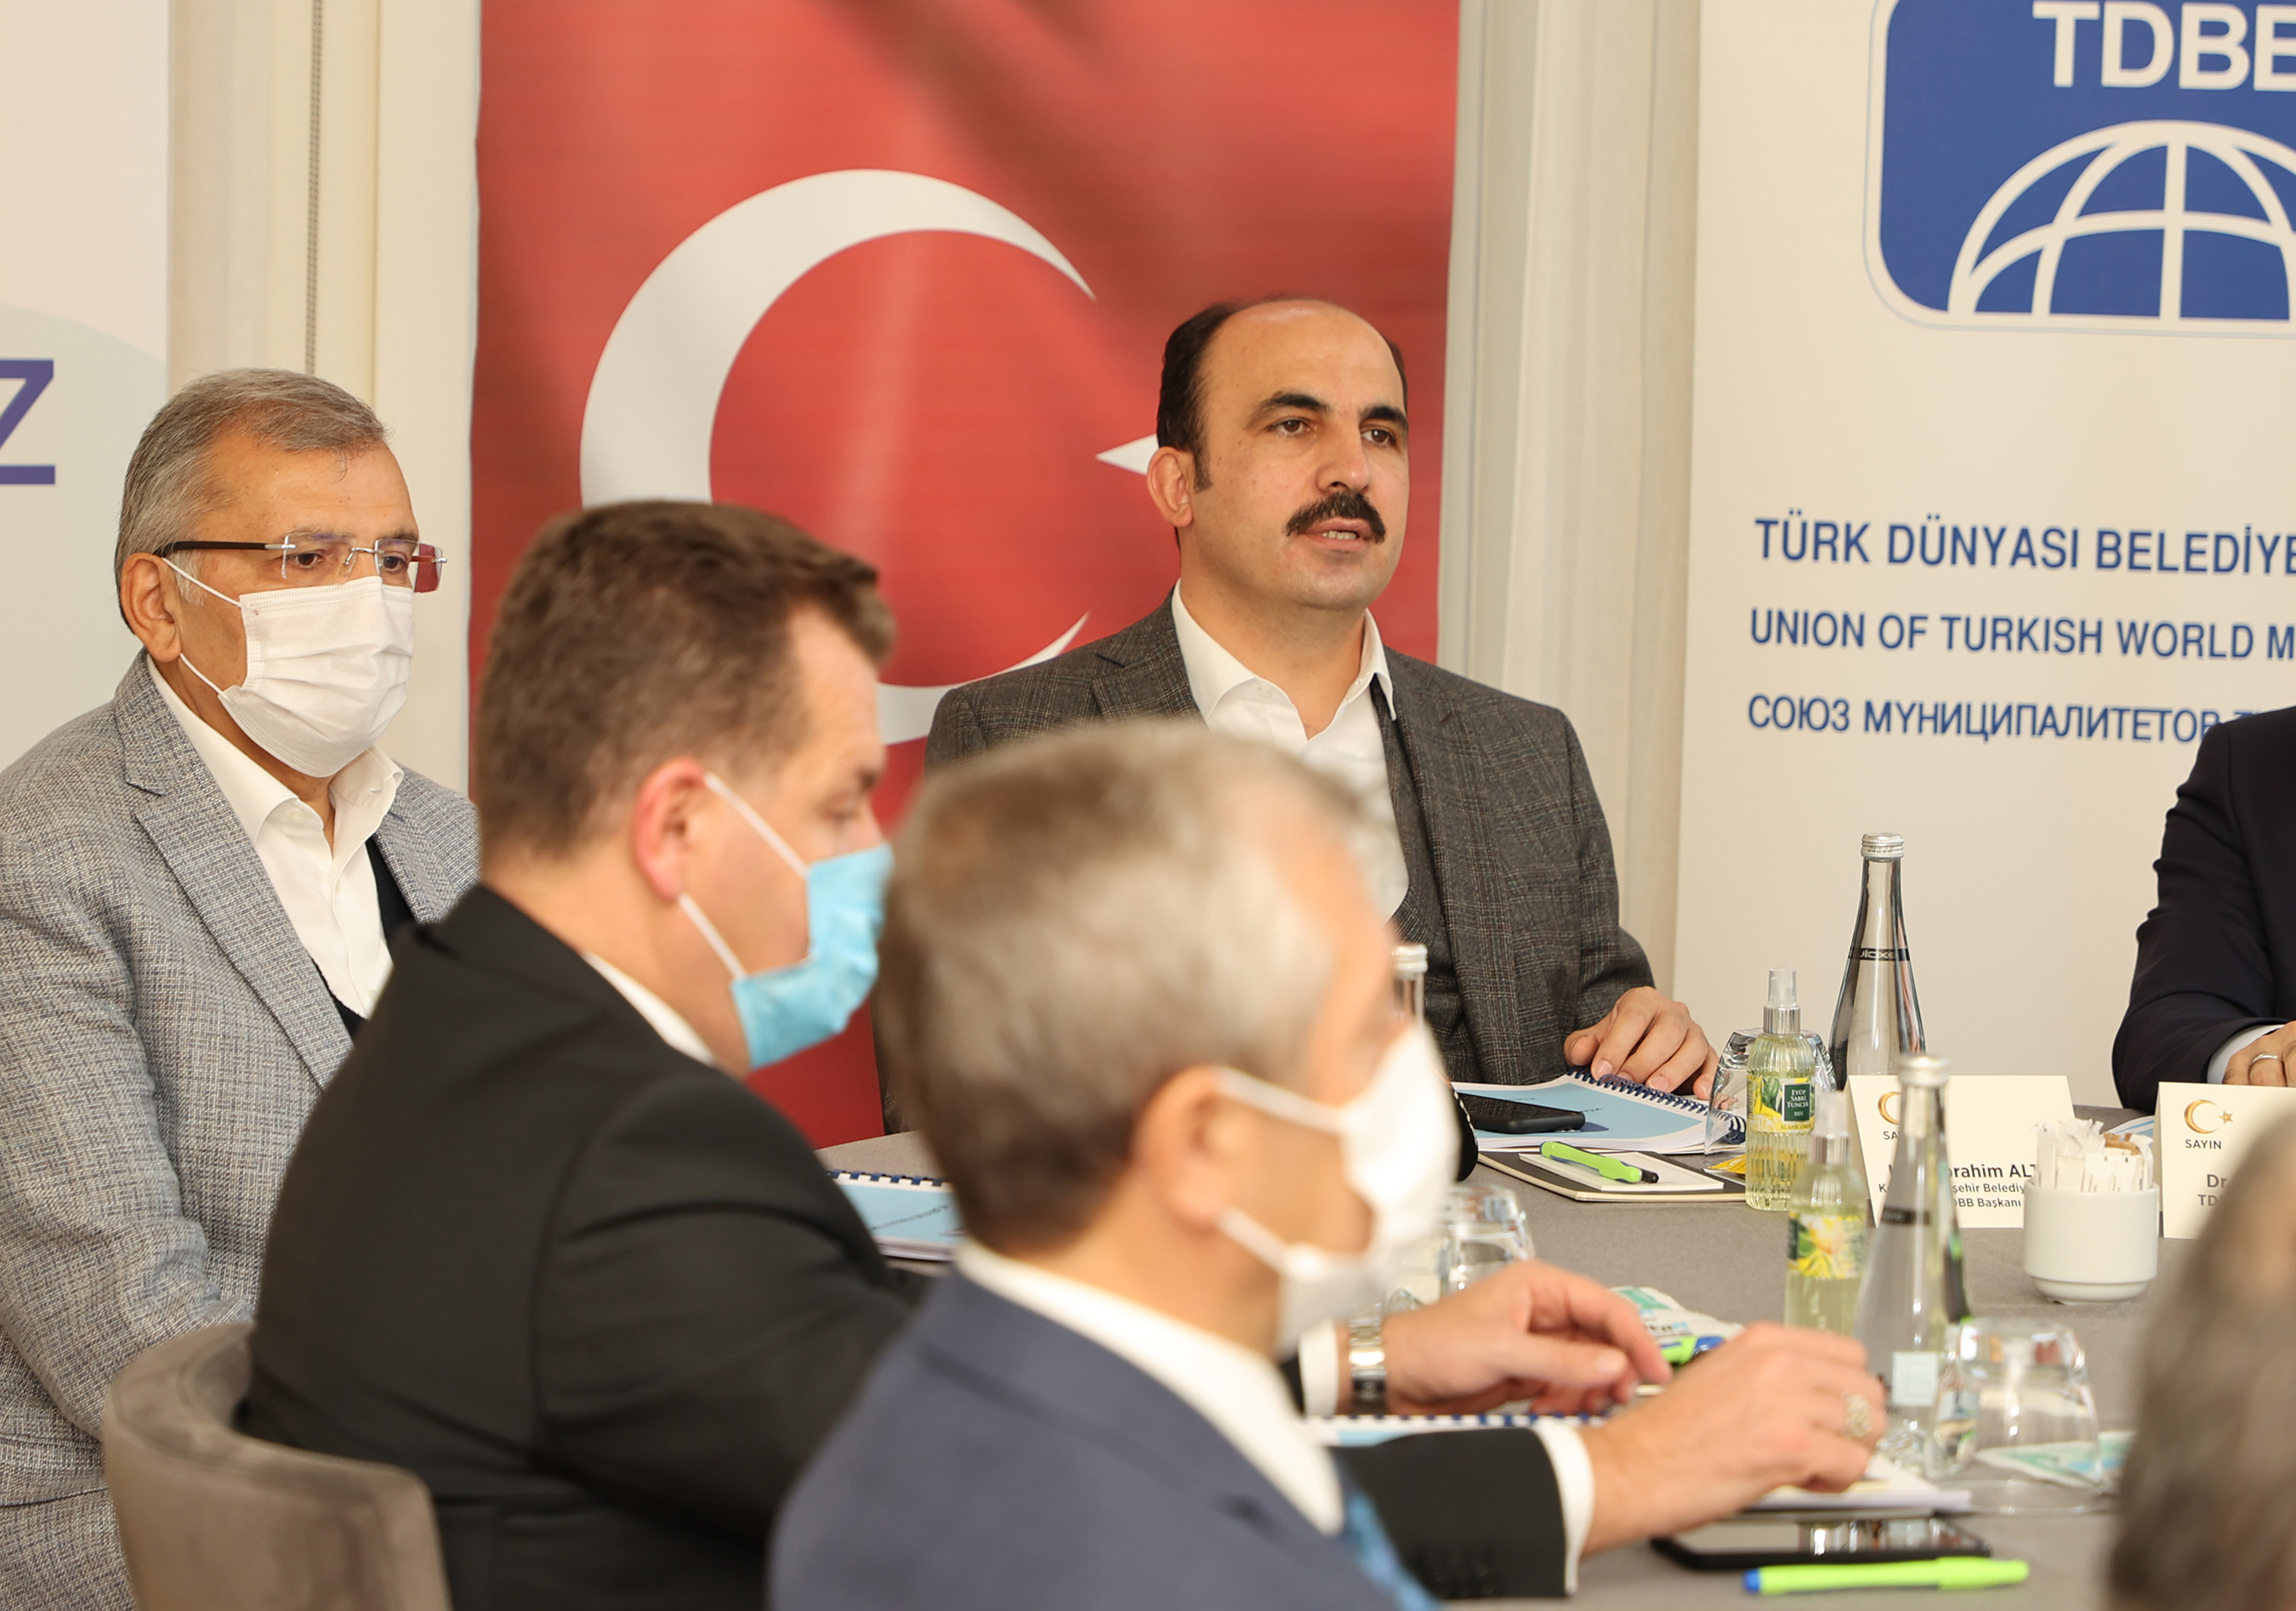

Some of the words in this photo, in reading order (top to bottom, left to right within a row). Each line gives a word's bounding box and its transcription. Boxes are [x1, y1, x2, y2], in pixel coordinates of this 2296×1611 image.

[1754, 508, 1871, 564] TÜRK
[1887, 513, 2079, 569] DÜNYASI
[1751, 608, 1866, 648] UNION
[1878, 613, 1929, 650] OF
[1940, 615, 2103, 655] TURKISH
[2116, 620, 2254, 659] WORLD
[1748, 694, 1850, 733] СОЮЗ
[2185, 1139, 2222, 1149] SAYIN
[1950, 1164, 2003, 1178] rahim
[1977, 1198, 2021, 1209] Başkanı
